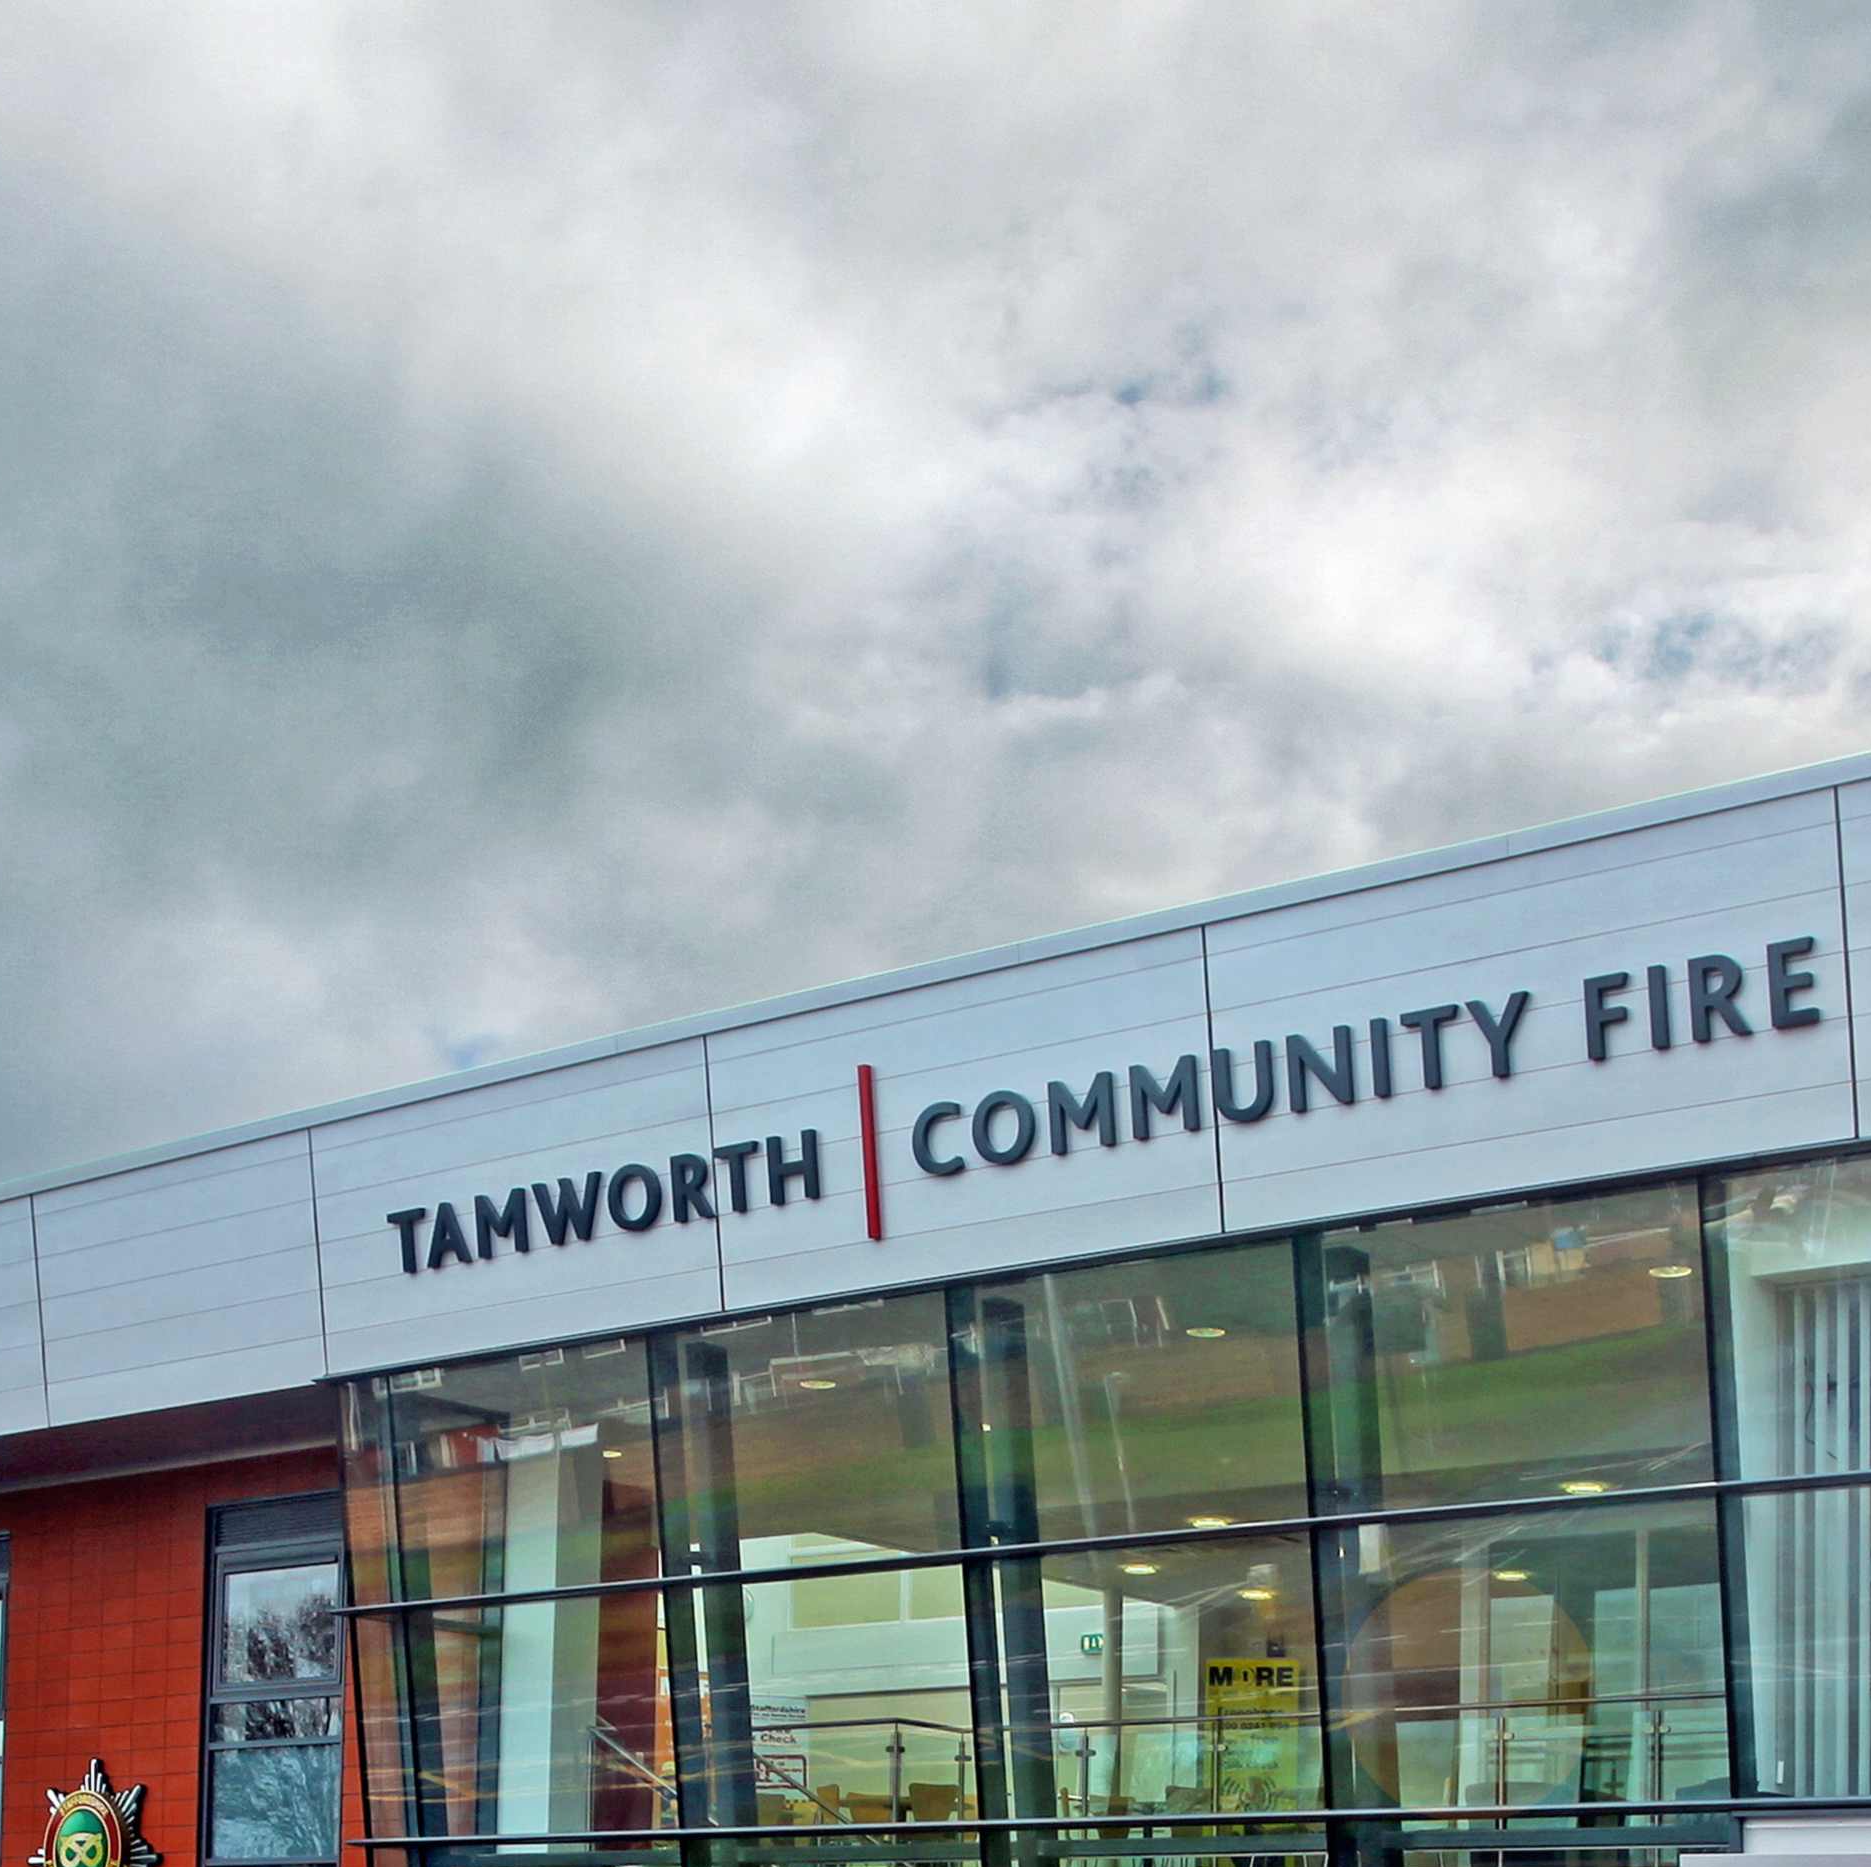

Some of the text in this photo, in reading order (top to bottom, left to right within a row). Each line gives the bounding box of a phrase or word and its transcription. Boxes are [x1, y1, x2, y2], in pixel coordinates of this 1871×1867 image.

[385, 1128, 822, 1275] TAMWORTH
[911, 989, 1532, 1179] COMMUNITY
[1582, 935, 1822, 1062] FIRE
